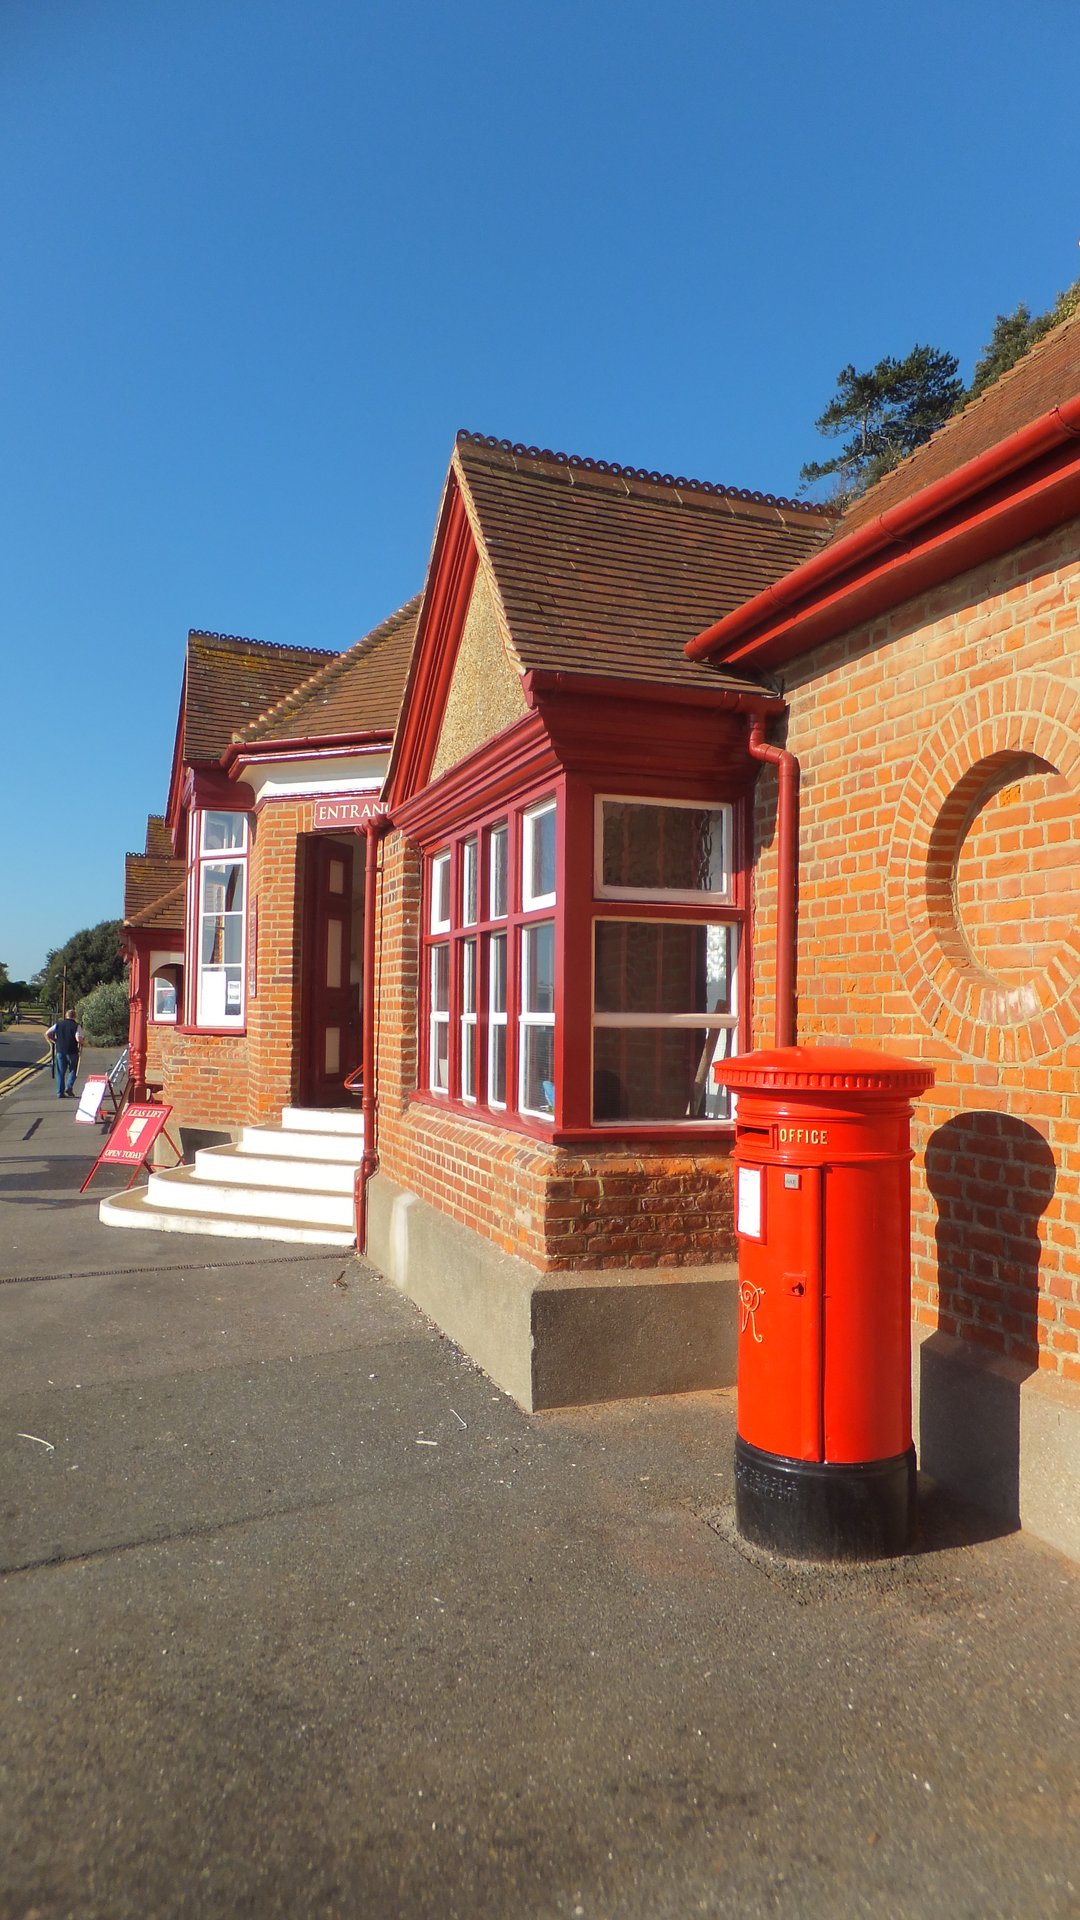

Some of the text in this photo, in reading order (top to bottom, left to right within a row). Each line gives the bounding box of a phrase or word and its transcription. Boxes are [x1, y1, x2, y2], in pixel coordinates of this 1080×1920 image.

[128, 1109, 164, 1118] LEAS LIFT
[780, 1128, 828, 1145] OFFICE
